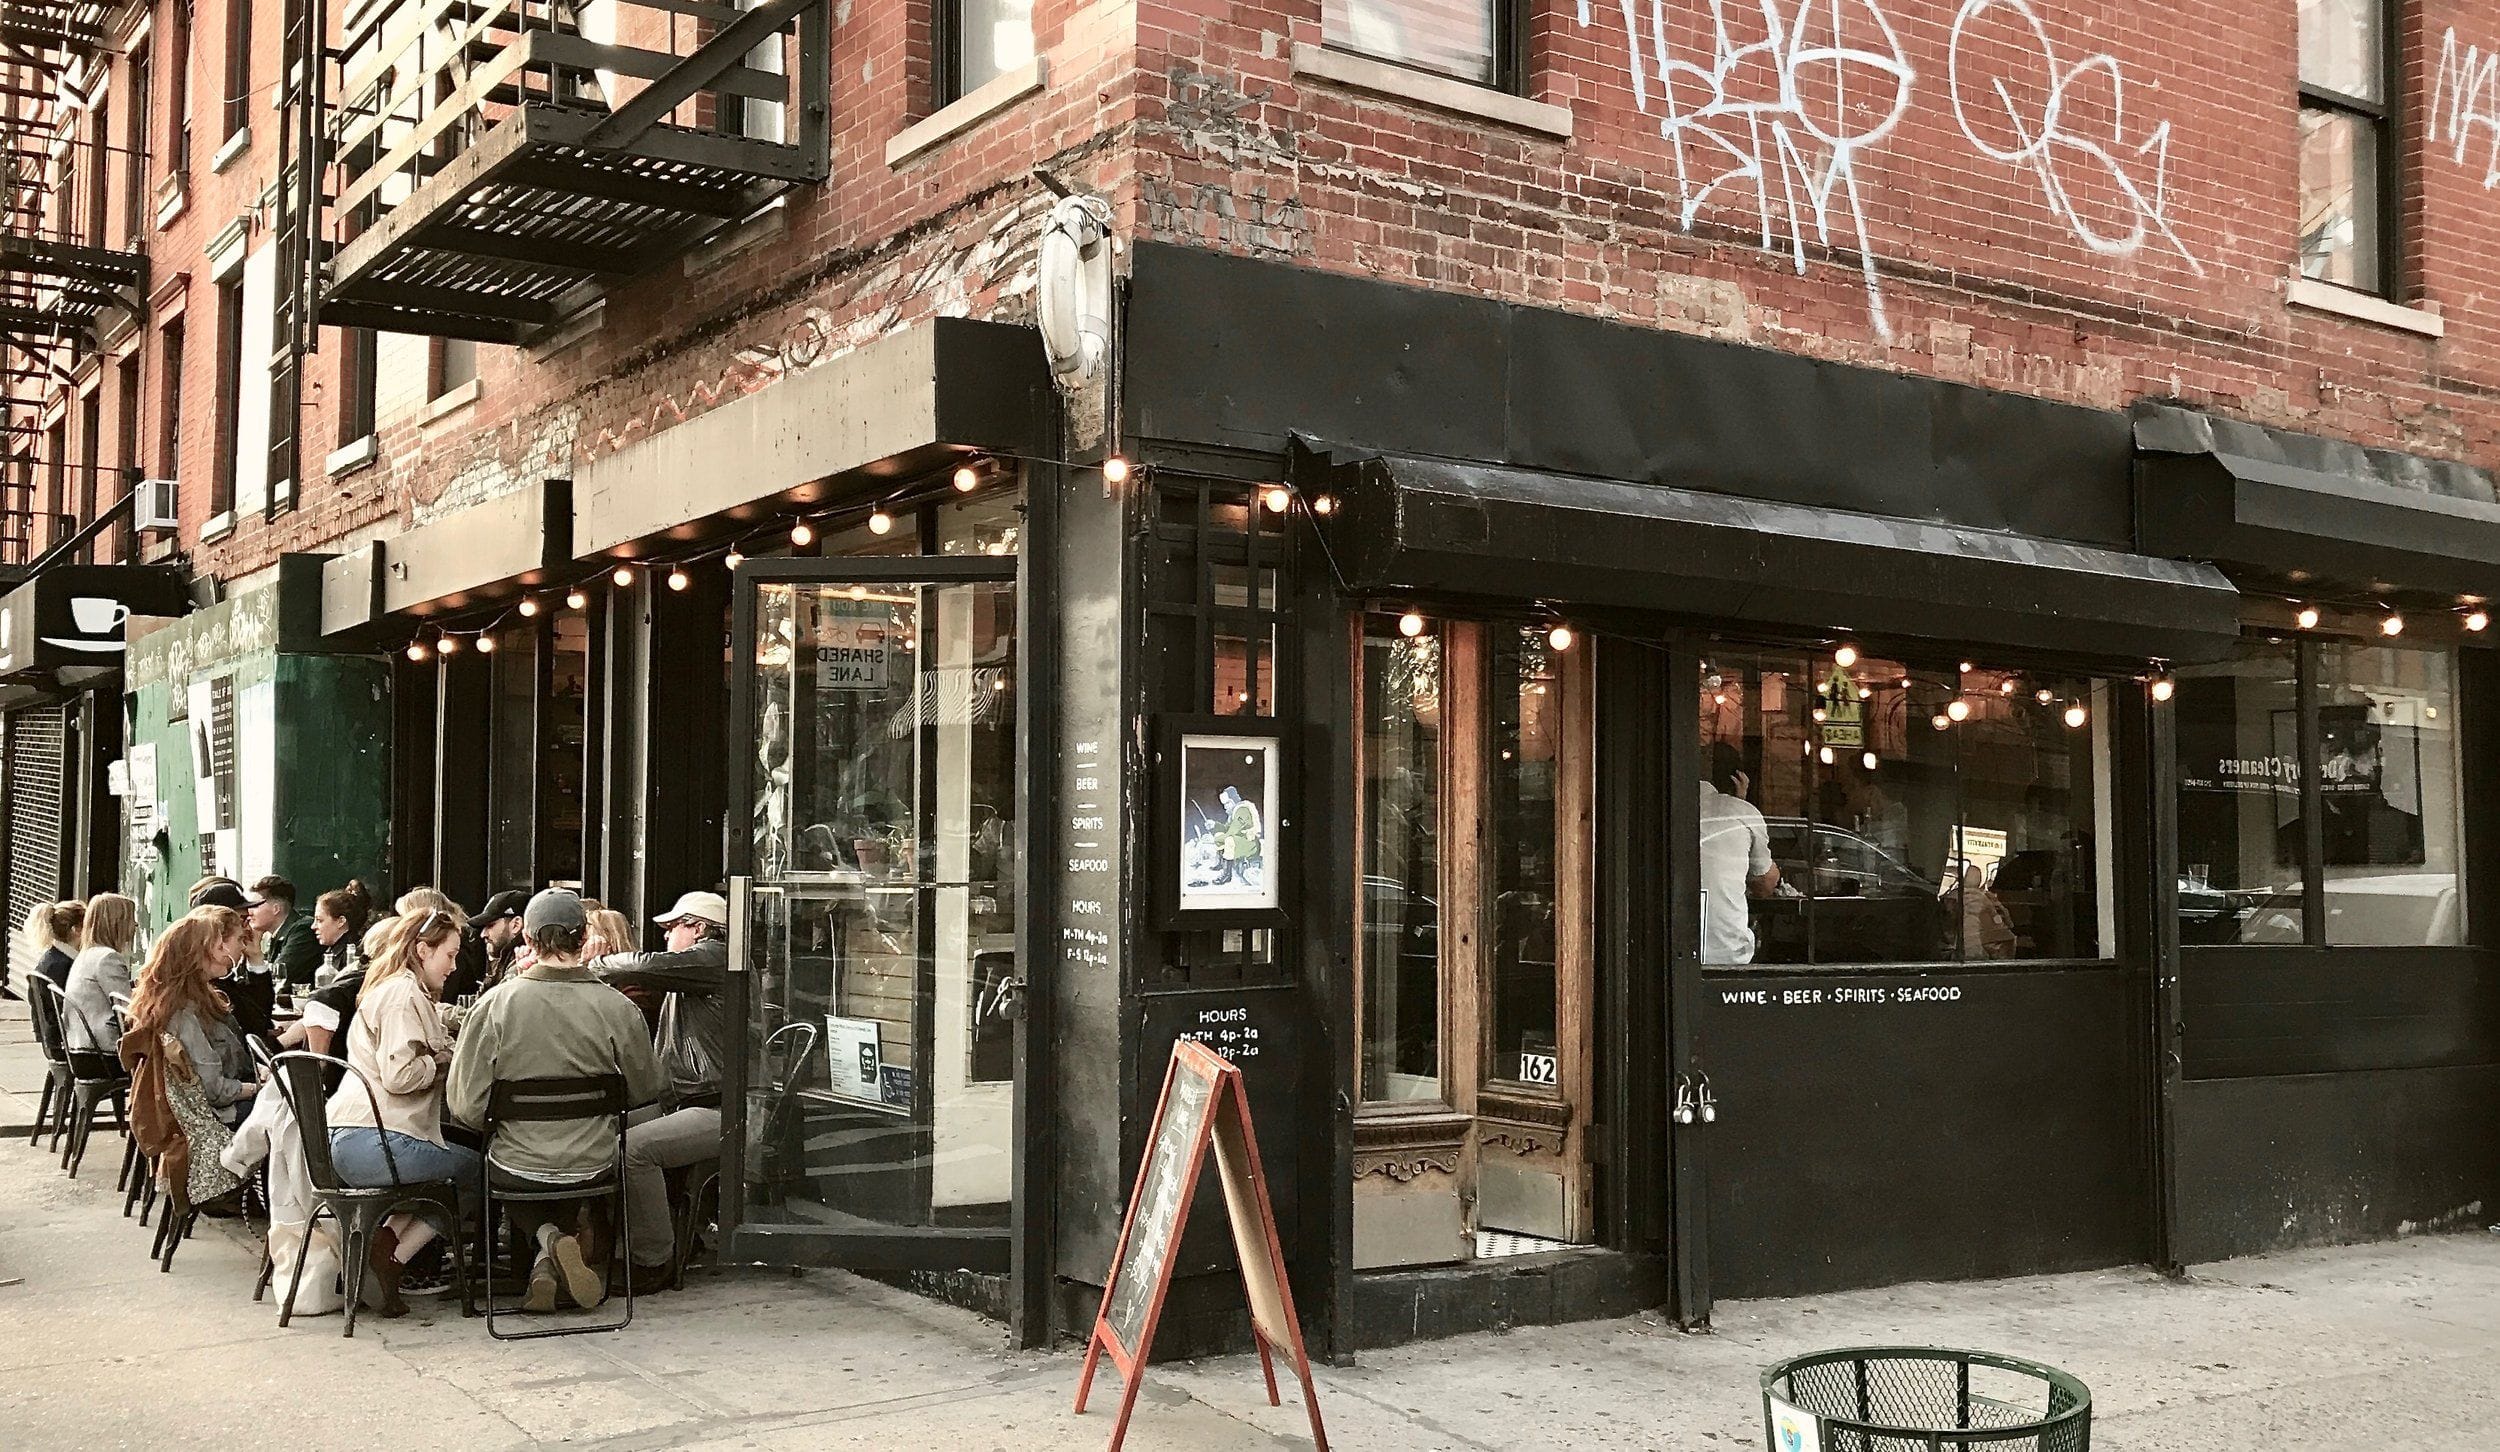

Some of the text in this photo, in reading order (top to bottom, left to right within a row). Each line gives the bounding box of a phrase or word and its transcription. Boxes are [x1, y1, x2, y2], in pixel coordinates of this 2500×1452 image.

[1076, 742, 1098, 754] WINE
[1076, 777, 1098, 791] BEER
[1072, 816, 1104, 830] SPIRITS
[1068, 859, 1108, 872] SEAFOOD
[1072, 900, 1101, 914] HOURS
[1722, 990, 1767, 1004] WINE
[1783, 989, 1822, 1004] BEER
[1897, 986, 1962, 1002] SEAFOOD
[1200, 1008, 1247, 1023] HOURS
[1523, 1056, 1555, 1082] 162
